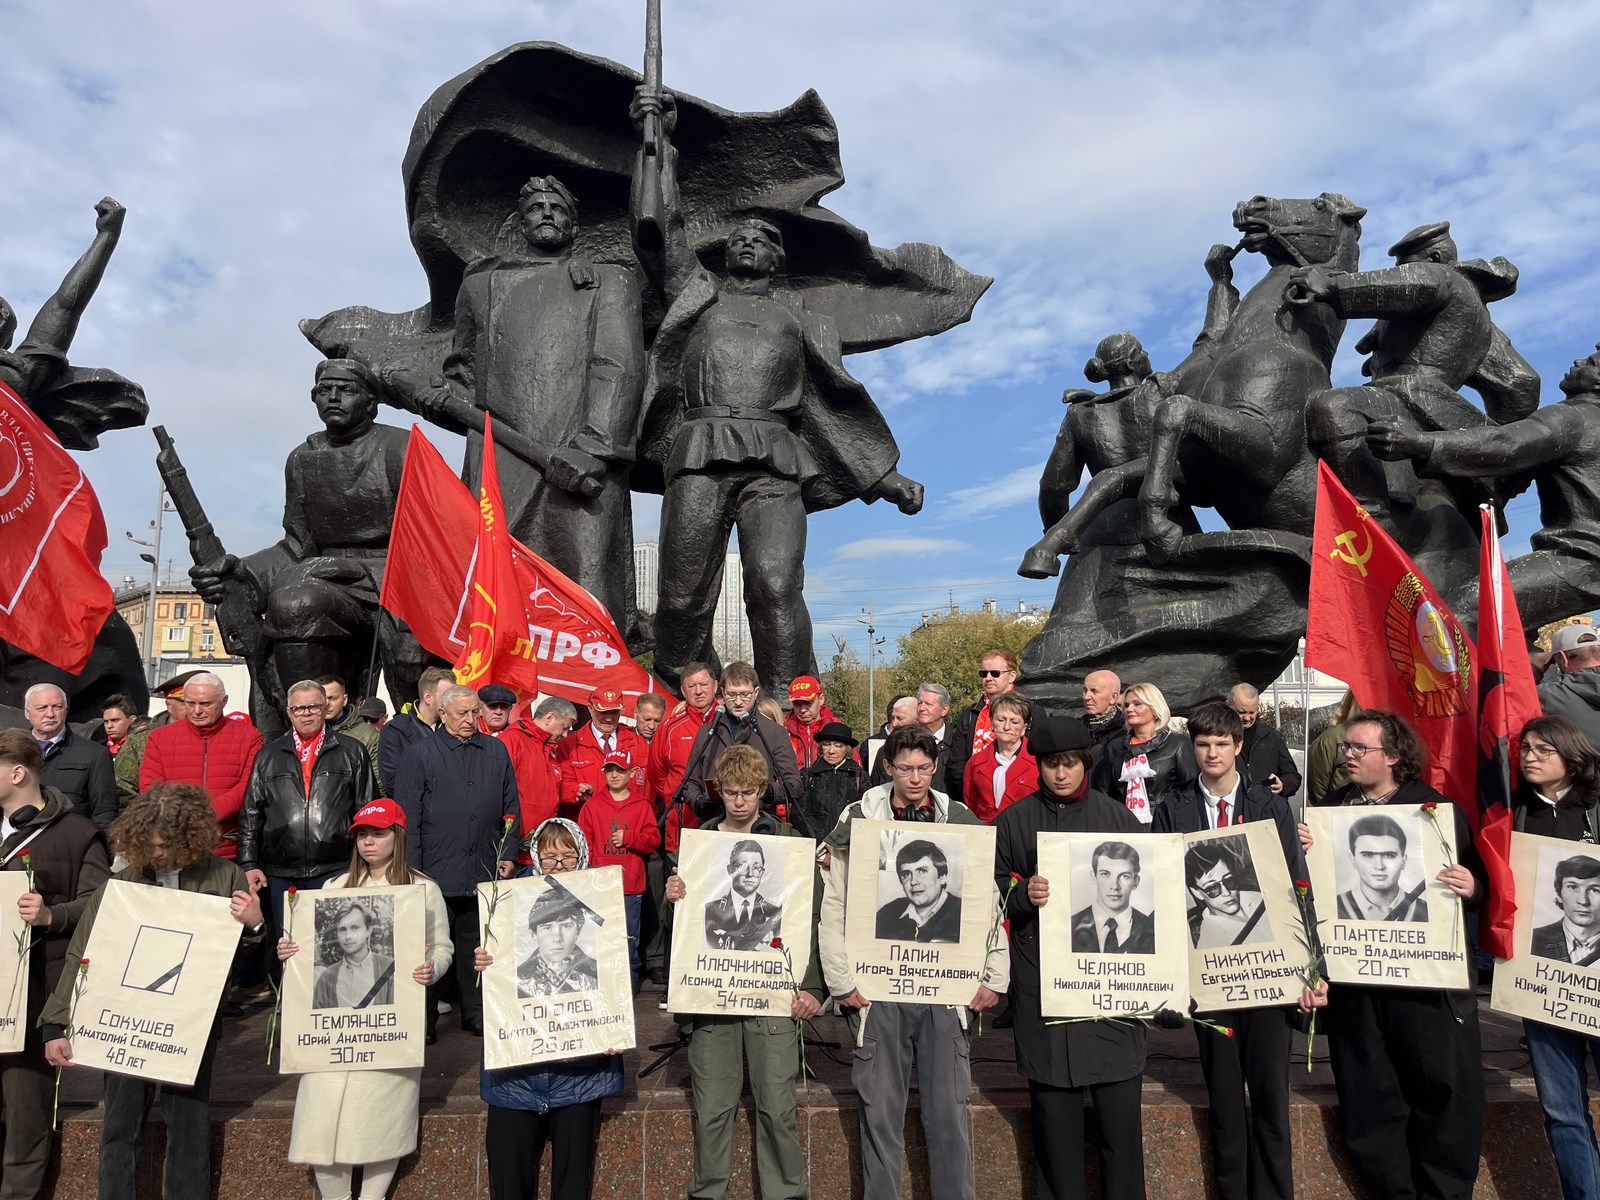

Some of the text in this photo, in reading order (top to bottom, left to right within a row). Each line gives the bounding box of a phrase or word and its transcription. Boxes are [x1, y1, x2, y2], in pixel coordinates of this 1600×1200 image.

[792, 682, 811, 692] СССР
[358, 805, 386, 817] КПРФ
[1333, 924, 1426, 945] ПАНТЕЛЕЕВ
[890, 944, 940, 963] ПАПИН
[1203, 948, 1286, 970] НИКИТИН
[696, 953, 783, 975] КЛЮЧНИКОВ
[855, 961, 980, 980] ИГОРЬ ВЯЧЕСЛАВОВИЧ
[1077, 958, 1146, 976] ЧЕЛЯКОВ
[1357, 959, 1410, 978] 20 ЛЕТ
[680, 973, 801, 992] ЛЕОНИД АЛЕКСАНДРОВИ
[888, 978, 940, 997] 38 ЛЕТ
[1514, 976, 1548, 995] ЮРИЙ
[716, 990, 738, 1008] 54
[1092, 993, 1113, 1011] 43
[1221, 984, 1285, 1002] 23 ГОДА
[98, 1008, 175, 1038] СОКУШЕВ
[310, 1012, 397, 1030] ТЕМЛЯНЦЕВ
[1543, 998, 1600, 1029] 42 ГОД
[297, 1031, 408, 1046] ЮРИЙ АНАТОЛЬЕВИЧ
[105, 1046, 127, 1065] 48
[329, 1046, 376, 1064] 30 ЛЕТ
